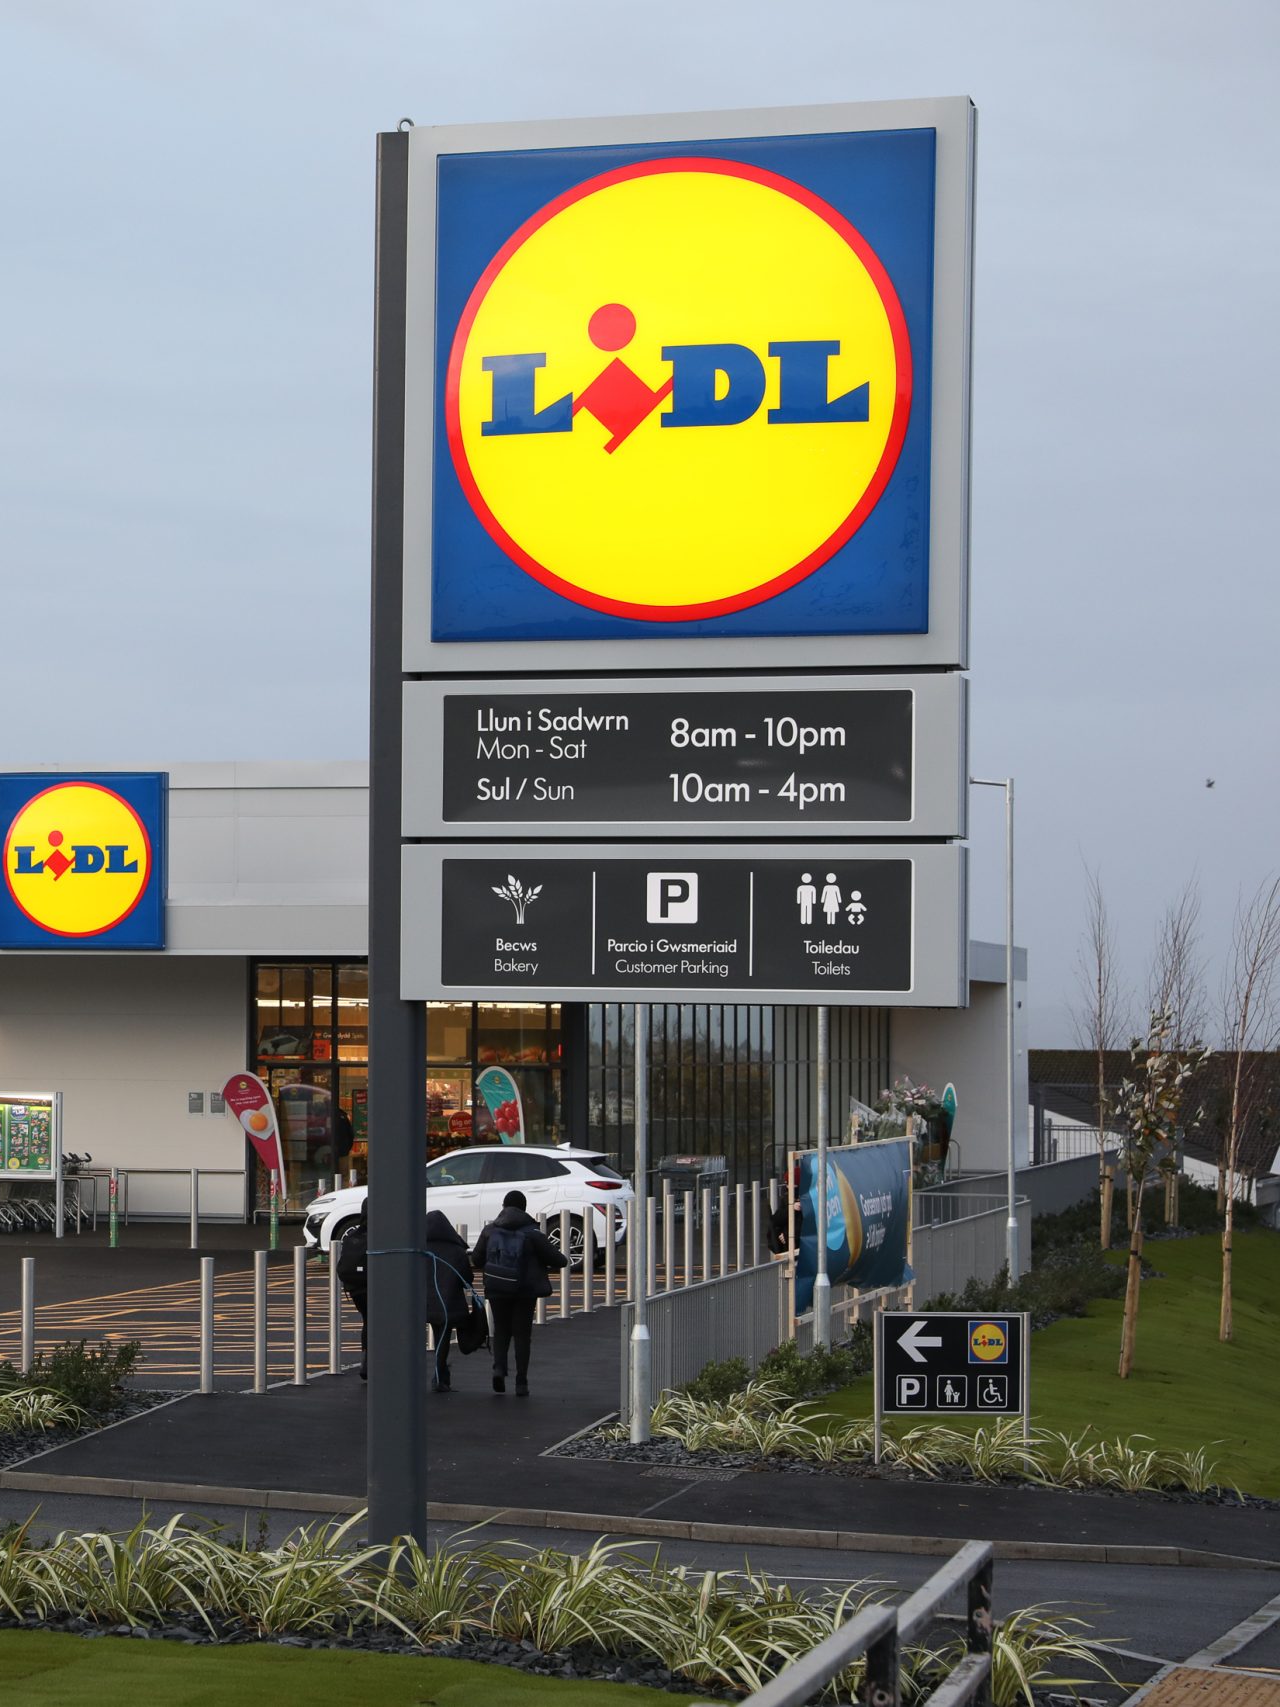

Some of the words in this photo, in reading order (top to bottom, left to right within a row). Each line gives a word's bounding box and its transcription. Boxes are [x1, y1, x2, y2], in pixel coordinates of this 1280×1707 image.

[477, 708, 521, 732] Llun
[527, 710, 532, 731] i
[537, 707, 629, 732] Sadwrn
[476, 736, 530, 760] Mon
[549, 736, 588, 760] Sat
[670, 717, 737, 748] 8am
[764, 717, 846, 755] 10pm
[476, 777, 510, 801] Sul
[515, 777, 528, 801] /
[533, 777, 575, 801] Sun
[669, 772, 750, 803] 10am
[777, 772, 846, 811] 4pm
[660, 879, 690, 918] P
[495, 937, 538, 952] Becws
[607, 938, 648, 953] Parcio
[650, 939, 654, 953] i
[656, 938, 737, 953] Gwsmeriaid
[803, 939, 860, 955] Toiledau
[494, 957, 539, 976] Bakery
[615, 959, 678, 975] Customer
[681, 959, 729, 978] Parking
[811, 960, 851, 976] Toilets
[900, 1378, 920, 1405] P
